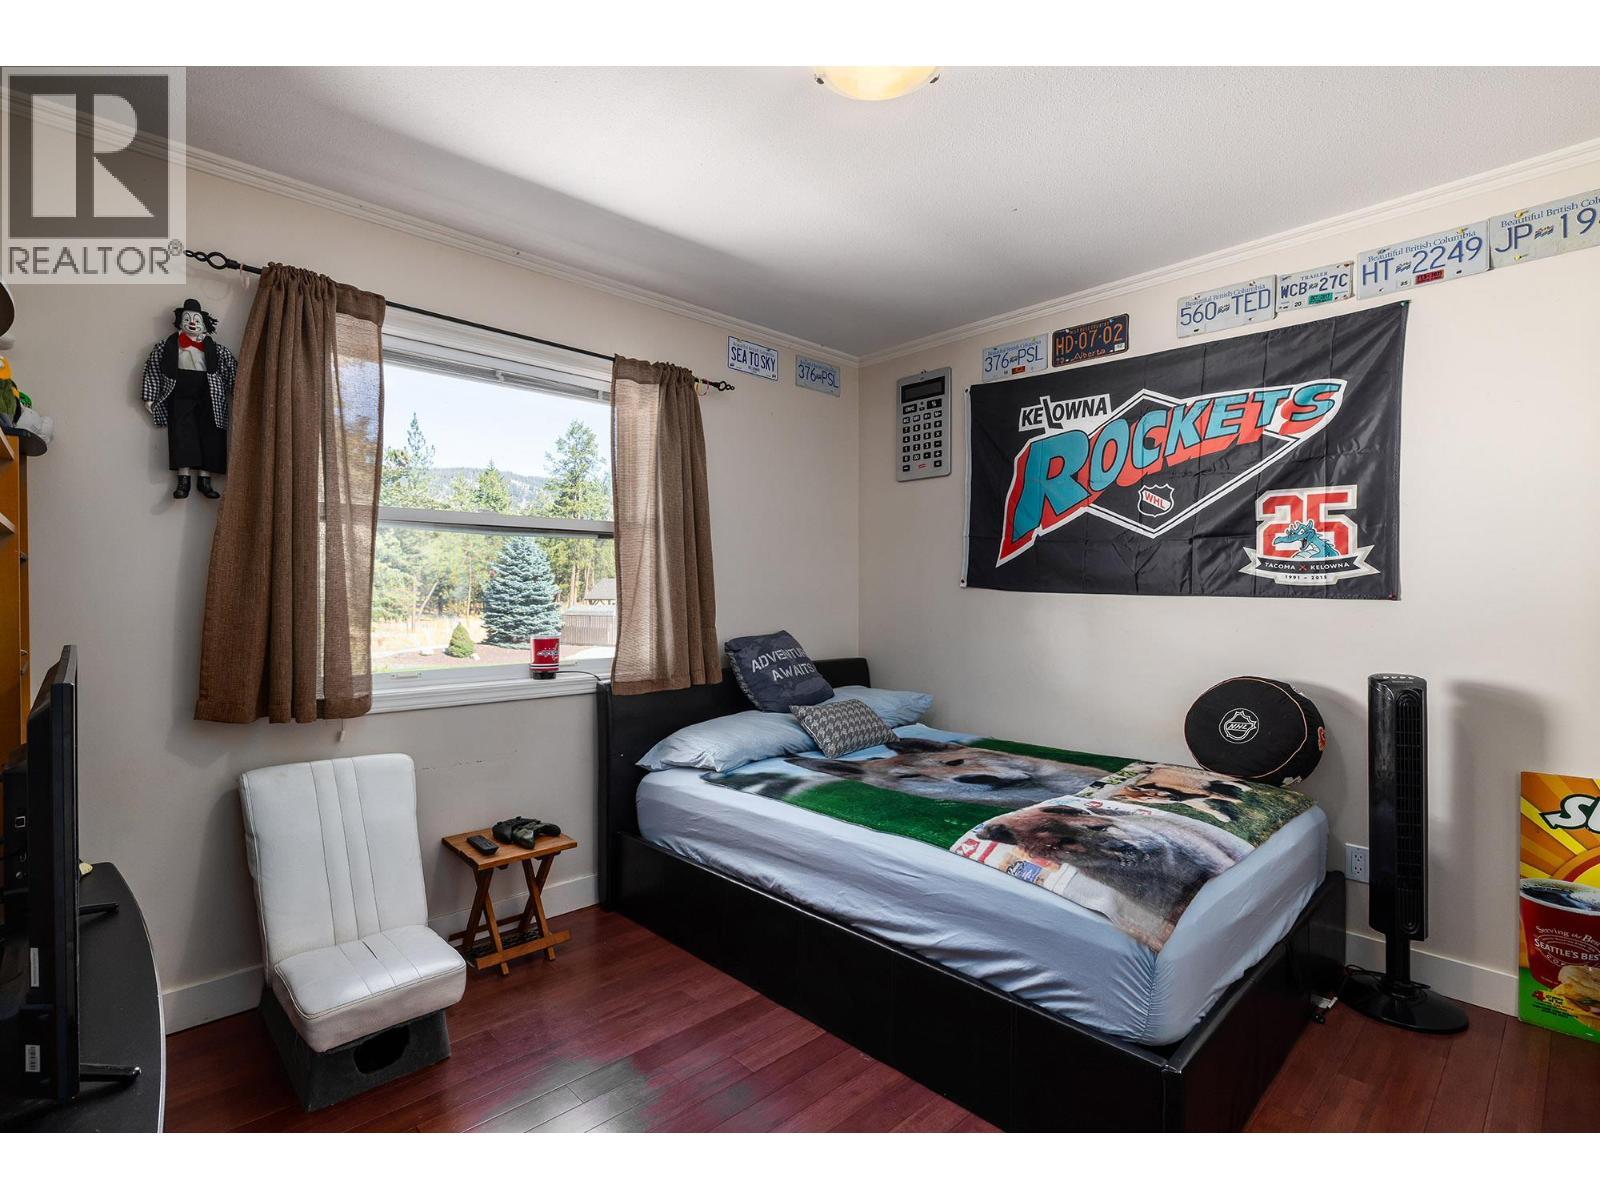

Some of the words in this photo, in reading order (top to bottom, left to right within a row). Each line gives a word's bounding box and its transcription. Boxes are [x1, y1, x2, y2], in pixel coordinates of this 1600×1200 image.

[1501, 212, 1543, 228] Beautiful
[1546, 203, 1578, 217] British
[1368, 247, 1404, 262] Beautiful
[1405, 241, 1432, 254] British
[1433, 231, 1476, 246] Columbia
[1494, 223, 1533, 253] JP
[1362, 257, 1395, 286] HT
[1412, 236, 1483, 274] 2249
[1280, 281, 1308, 299] WCB
[1318, 272, 1349, 291] 27C
[1301, 271, 1328, 281] TRAILER
[1180, 300, 1217, 326] 560
[1231, 288, 1271, 315] TED
[731, 346, 748, 365] SEA
[749, 351, 760, 368] TO
[760, 354, 776, 372] SKY
[984, 351, 1010, 373] 376
[1017, 345, 1045, 366] PSL
[798, 364, 817, 382] 376
[1010, 381, 1345, 545] ROCKETS
[1144, 490, 1167, 510] WHL
[1259, 489, 1353, 559] 25
[1264, 561, 1296, 571] TACOMA
[1309, 561, 1351, 571] KELOWNA
[771, 662, 817, 681] AWAITS
[1534, 938, 1579, 959] SEATTLE'S
